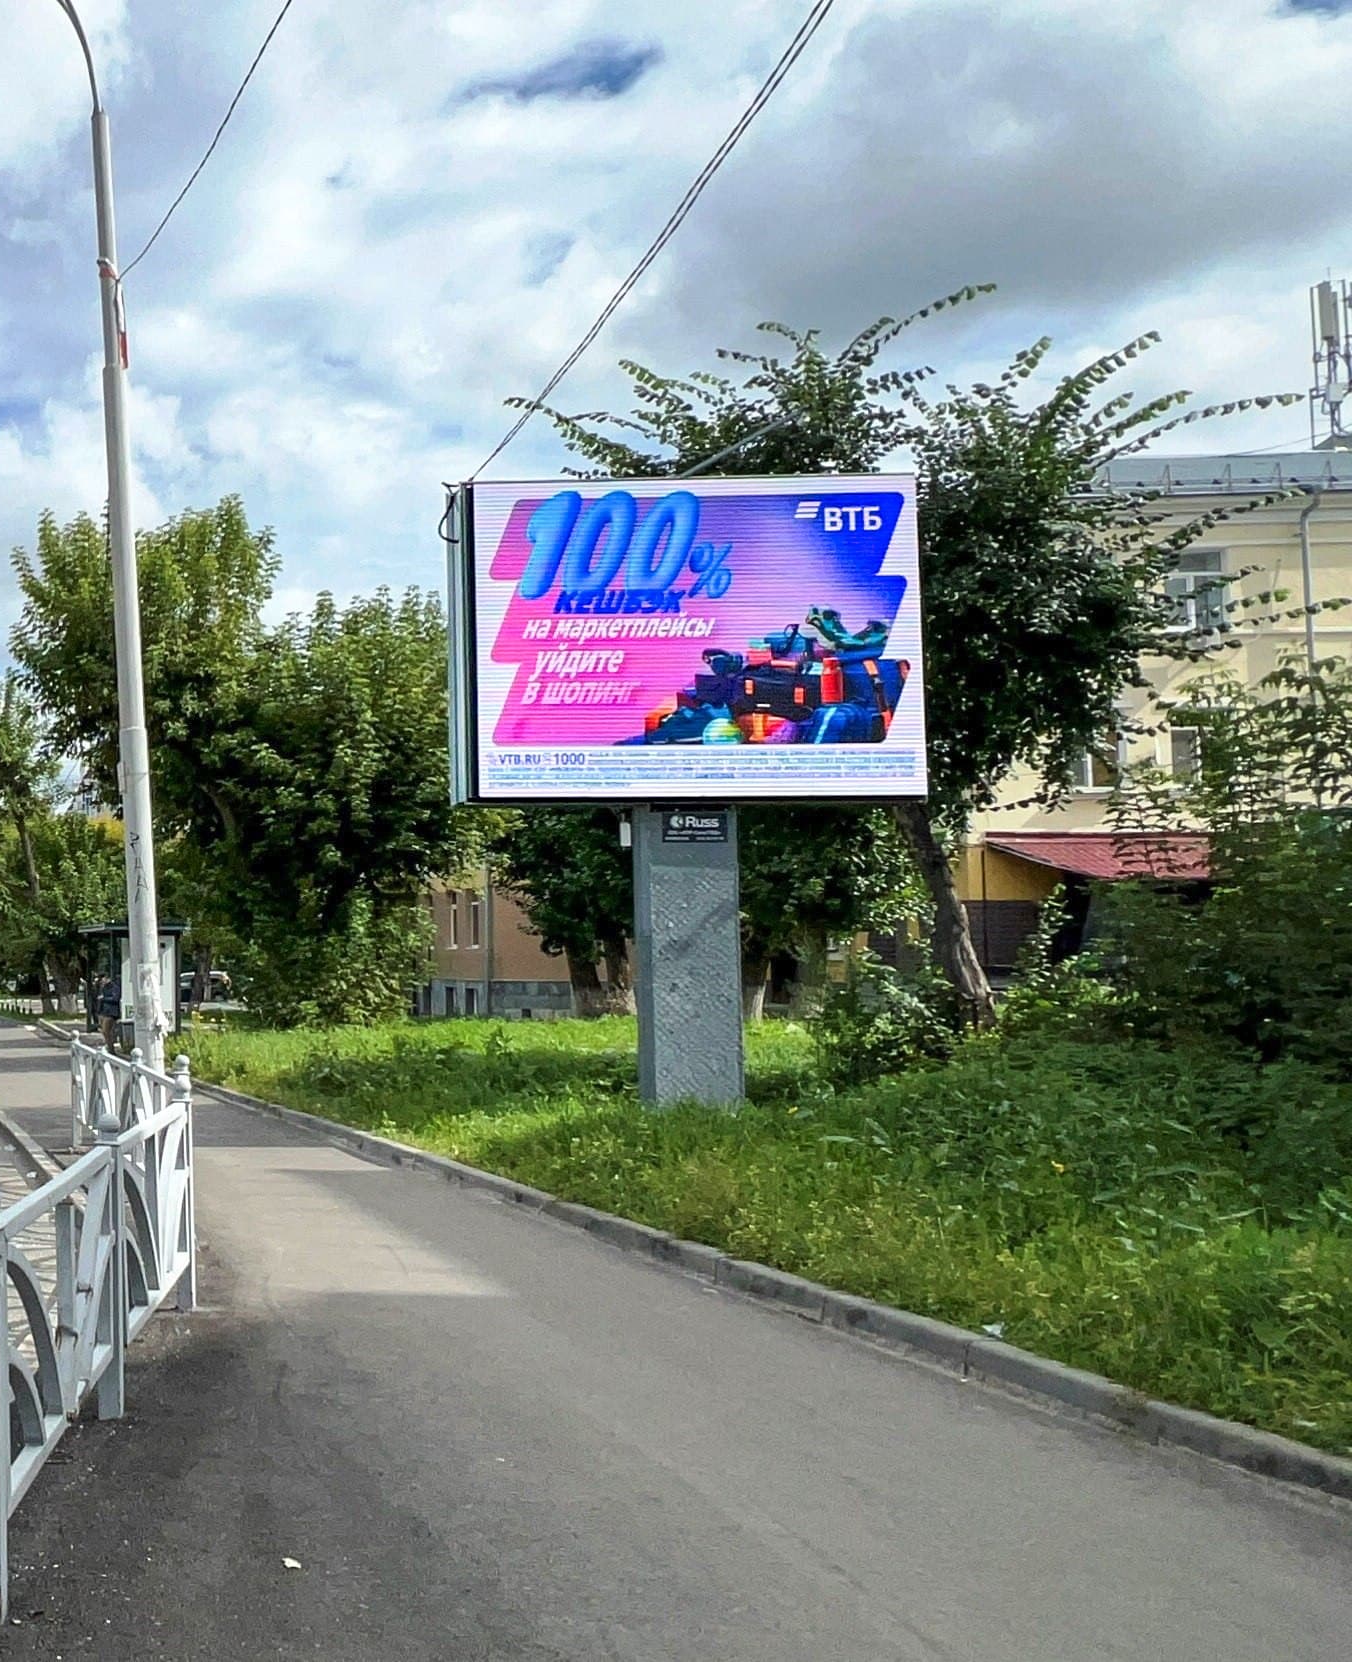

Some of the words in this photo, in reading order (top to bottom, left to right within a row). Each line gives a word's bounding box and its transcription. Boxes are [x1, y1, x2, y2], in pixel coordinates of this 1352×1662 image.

[824, 506, 882, 531] ВТБ
[520, 490, 733, 600] 100%
[522, 619, 551, 639] на
[553, 611, 715, 643] маркетплейсы
[529, 643, 624, 681] уйдите
[499, 754, 541, 765] VTB.RU
[554, 753, 586, 765] 1000
[685, 816, 719, 828] Russ
